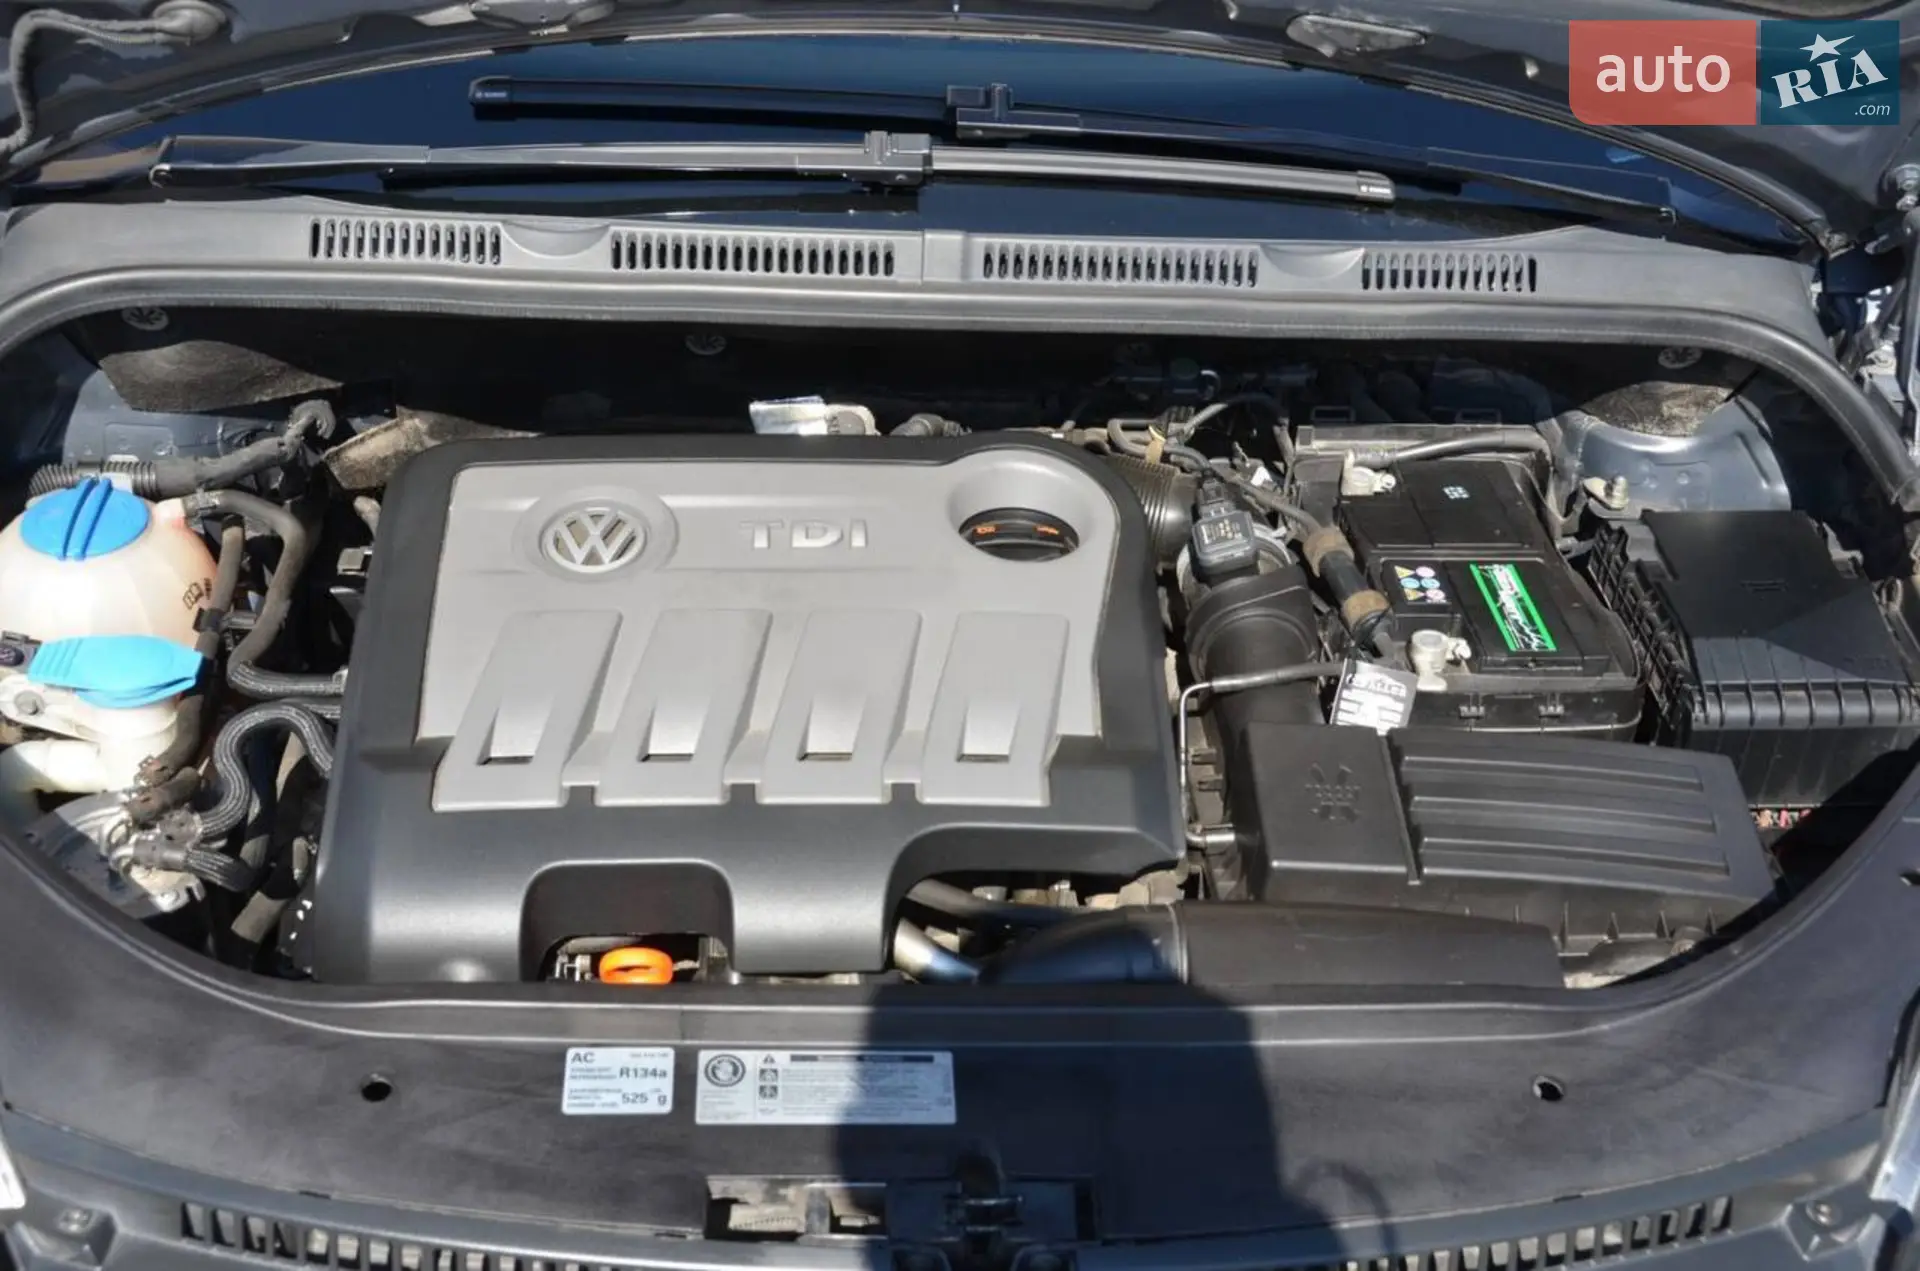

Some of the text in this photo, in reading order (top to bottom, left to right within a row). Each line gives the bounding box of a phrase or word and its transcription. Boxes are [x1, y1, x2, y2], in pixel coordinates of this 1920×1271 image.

[740, 519, 868, 549] TDI
[571, 1051, 596, 1064] AC
[619, 1067, 668, 1079] R134a
[621, 1092, 649, 1105] 525
[657, 1095, 668, 1107] g
